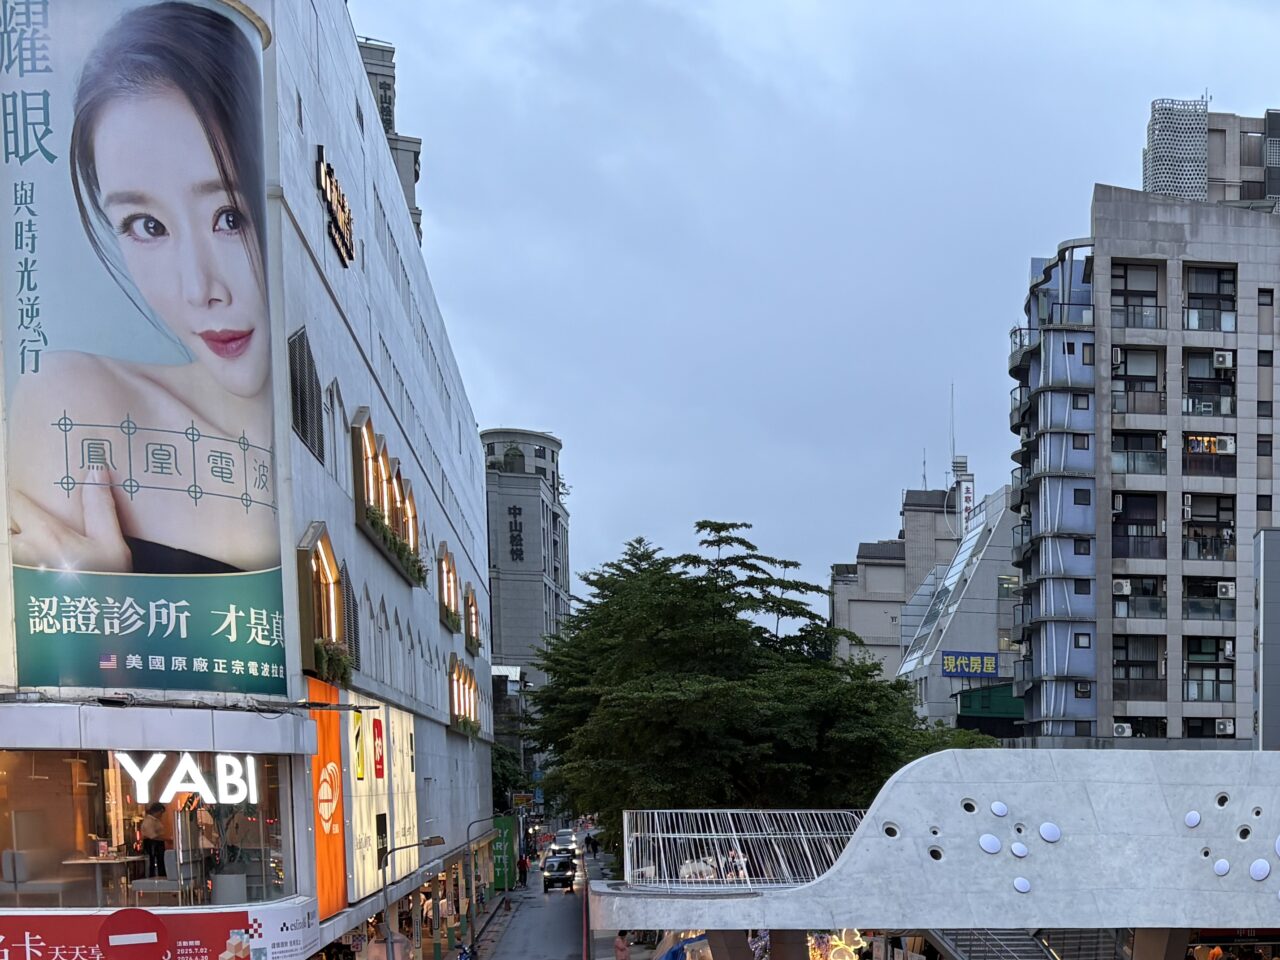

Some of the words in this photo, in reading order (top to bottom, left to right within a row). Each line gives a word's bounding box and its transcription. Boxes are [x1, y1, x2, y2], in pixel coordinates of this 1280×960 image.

[12, 180, 48, 375] 與時光逆行
[79, 437, 270, 491] 鳳凰電波
[28, 596, 191, 639] 認證診所
[943, 656, 996, 674] 現代房屋
[114, 752, 259, 804] YABI
